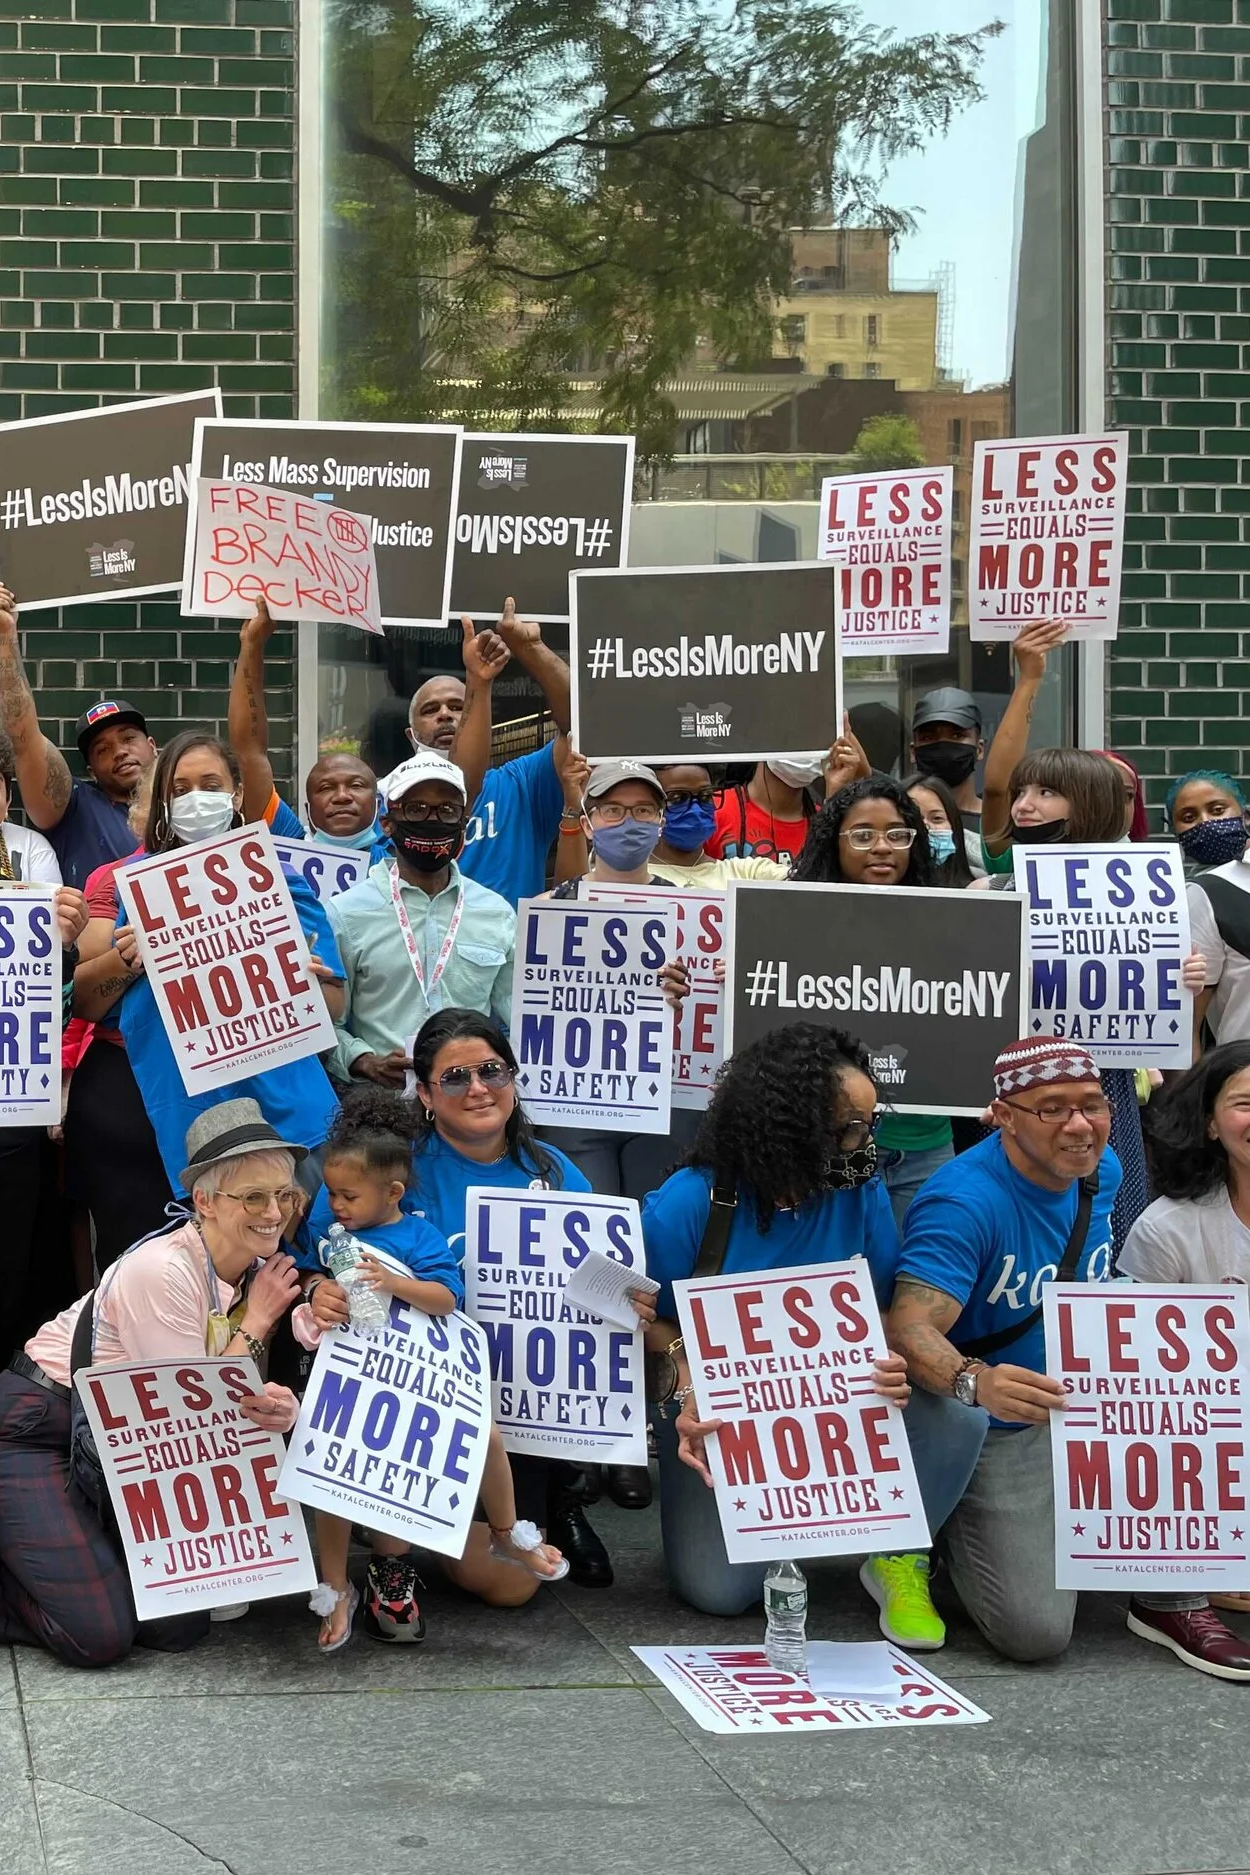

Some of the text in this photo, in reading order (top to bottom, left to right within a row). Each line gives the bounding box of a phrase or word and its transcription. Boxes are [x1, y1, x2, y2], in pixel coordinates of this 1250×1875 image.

[223, 455, 430, 491] Less Mass Supervision
[479, 457, 492, 470] NY
[486, 468, 512, 481] Less Is
[492, 457, 513, 469] More
[982, 447, 1116, 500] LESS
[0, 463, 191, 529] #LessIsMoreN
[210, 487, 322, 536] FREE
[828, 480, 943, 530] LESS
[981, 497, 1115, 515] SURVEILLANCE
[371, 518, 433, 547] Justice
[456, 514, 613, 557] #LessIsMo
[827, 525, 942, 543] SURVEILLANCE
[1006, 514, 1087, 540] EQUALS
[103, 549, 128, 563] Less Is
[104, 562, 124, 575] More
[124, 559, 136, 572] NY
[211, 523, 371, 610] BRANDY
[848, 541, 918, 565] EQUALS
[978, 540, 1112, 590] MORE
[842, 609, 922, 632] JUSTICE
[996, 591, 1088, 615] JUSTICE
[587, 630, 826, 679] #LessIsMoreNY
[696, 712, 723, 725] Less Is
[697, 725, 718, 738] More
[718, 724, 732, 737] NY
[129, 841, 274, 933] LESS
[1026, 858, 1175, 909] LESS
[147, 893, 283, 949] SURVEILLANCE
[1030, 911, 1178, 925] SURVEILLANCE
[180, 919, 266, 970] EQUALS
[525, 914, 666, 969] LESS
[1062, 929, 1150, 955] EQUALS
[163, 940, 310, 1034] MORE
[525, 968, 663, 987] SURVEILLANCE
[745, 960, 1010, 1017] #LessIsMoreNY
[1031, 959, 1181, 1010] MORE
[551, 986, 635, 1015] EQUALS
[205, 1001, 300, 1057] JUSTICE
[520, 1014, 663, 1073] MORE
[1053, 1014, 1157, 1039] SAFETY
[226, 1041, 294, 1070] KATALCENTER.ORG
[868, 1053, 898, 1068] Less Is
[540, 1069, 638, 1101] SAFETY
[892, 1069, 906, 1083] NY
[552, 1107, 623, 1118] KATALCENTER.ORG
[478, 1204, 634, 1269] LESS
[477, 1268, 566, 1287] SURVEIL
[389, 1295, 482, 1375] ESS
[689, 1281, 868, 1360] LESS
[1058, 1303, 1238, 1373] LESS
[477, 1321, 633, 1393] MORE
[704, 1347, 875, 1380] SURVEILLANCE
[359, 1346, 456, 1408] EQUALS
[742, 1372, 849, 1413] EQUALS
[1064, 1377, 1241, 1395] SURVEILLANCE
[89, 1367, 256, 1431] LESS
[501, 1387, 609, 1426] SAFETY
[1100, 1401, 1208, 1435] EQUALS
[107, 1409, 249, 1448] SURVEILLAN
[309, 1369, 479, 1484] MORE
[515, 1431, 595, 1446] KATALCENTER.ORG
[717, 1406, 900, 1486] MORE
[144, 1427, 241, 1474] EQUALS
[323, 1441, 440, 1508] SAFETY
[1066, 1440, 1245, 1511] MORE
[121, 1454, 290, 1544] MORE
[331, 1488, 414, 1525] KATALCENTER.ORG
[759, 1479, 882, 1521] JUSTICE
[164, 1525, 274, 1576] JUSTICE
[781, 1527, 870, 1541] KATALCENTER.ORG
[1097, 1516, 1220, 1550] JUSTICE
[184, 1574, 264, 1595] KATALCENTER.ORG
[1116, 1565, 1205, 1573] KATALCENTER.ORG
[684, 1662, 758, 1715] JUSTICE
[707, 1652, 843, 1725] MORE
